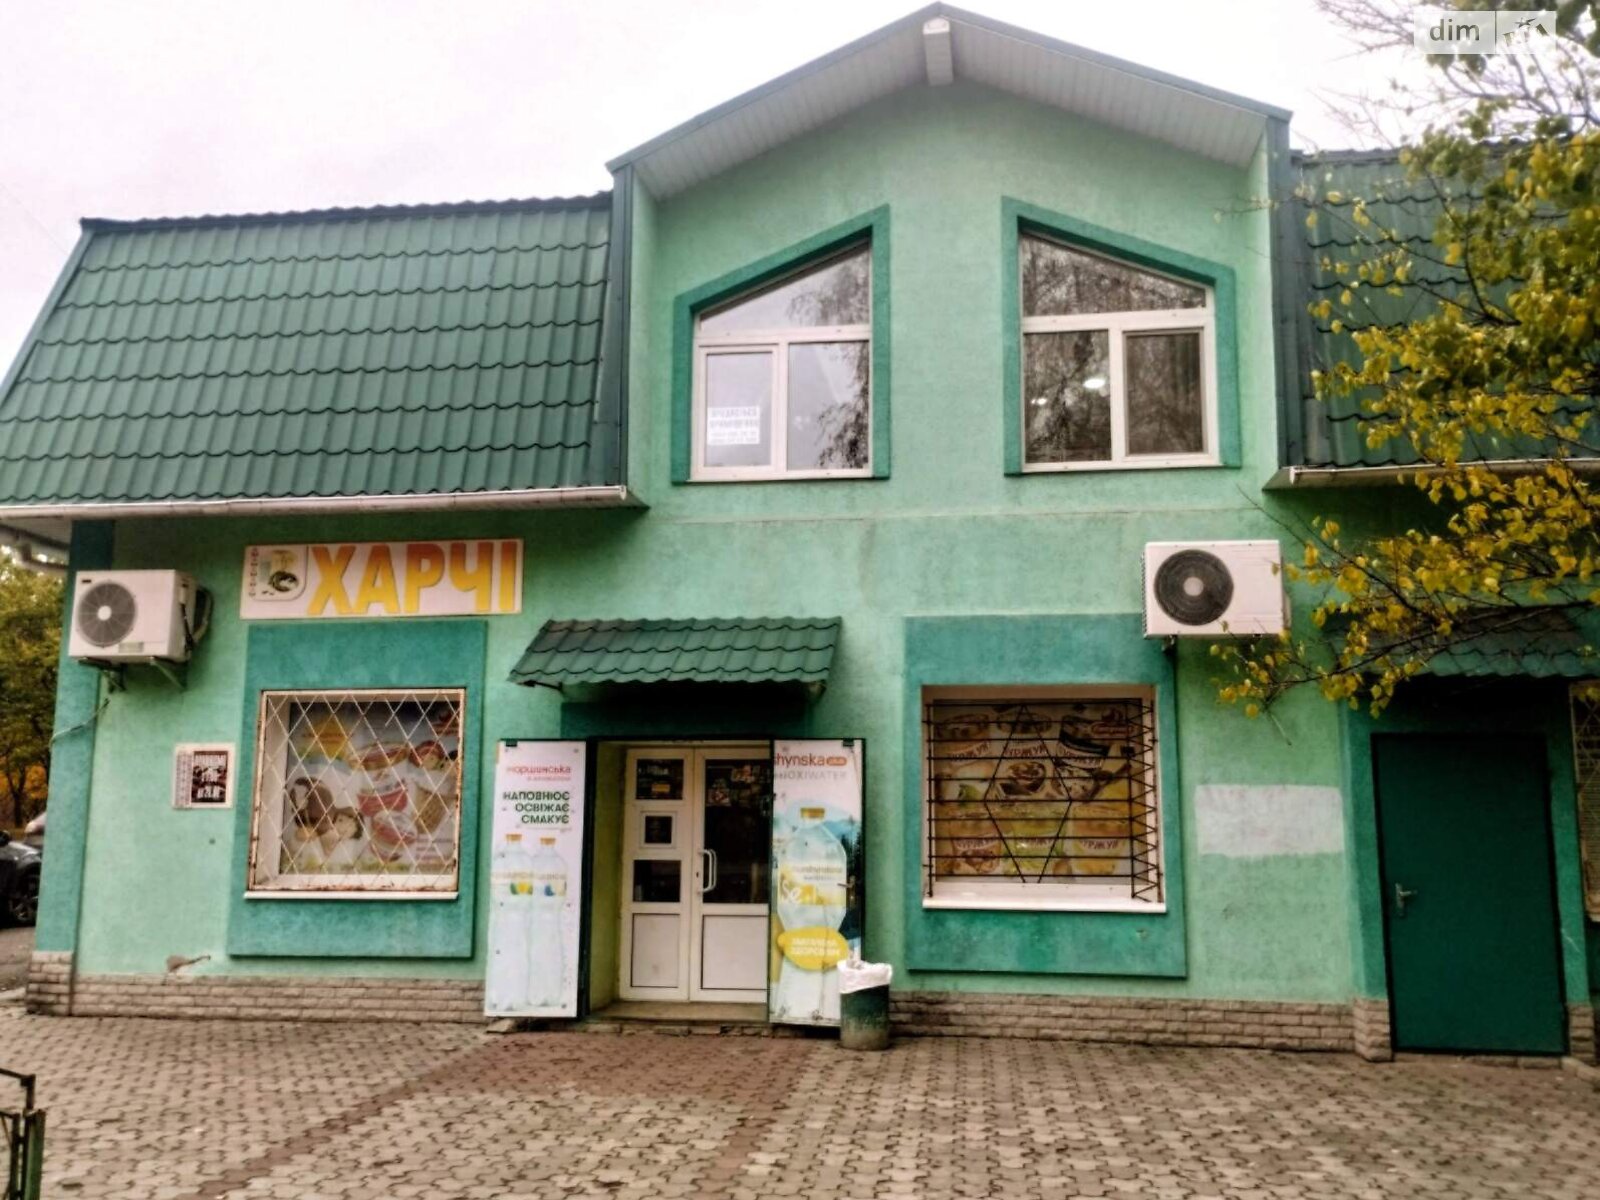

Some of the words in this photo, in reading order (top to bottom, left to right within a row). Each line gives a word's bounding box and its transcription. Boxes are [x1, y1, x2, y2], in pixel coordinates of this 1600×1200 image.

[307, 541, 519, 616] ХАРЧІ
[774, 753, 825, 768] hynska
[502, 790, 571, 801] НАПОВНЮЄ
[514, 803, 570, 813] ОСВІЖАЄ
[521, 814, 570, 824] СМАКУЄ
